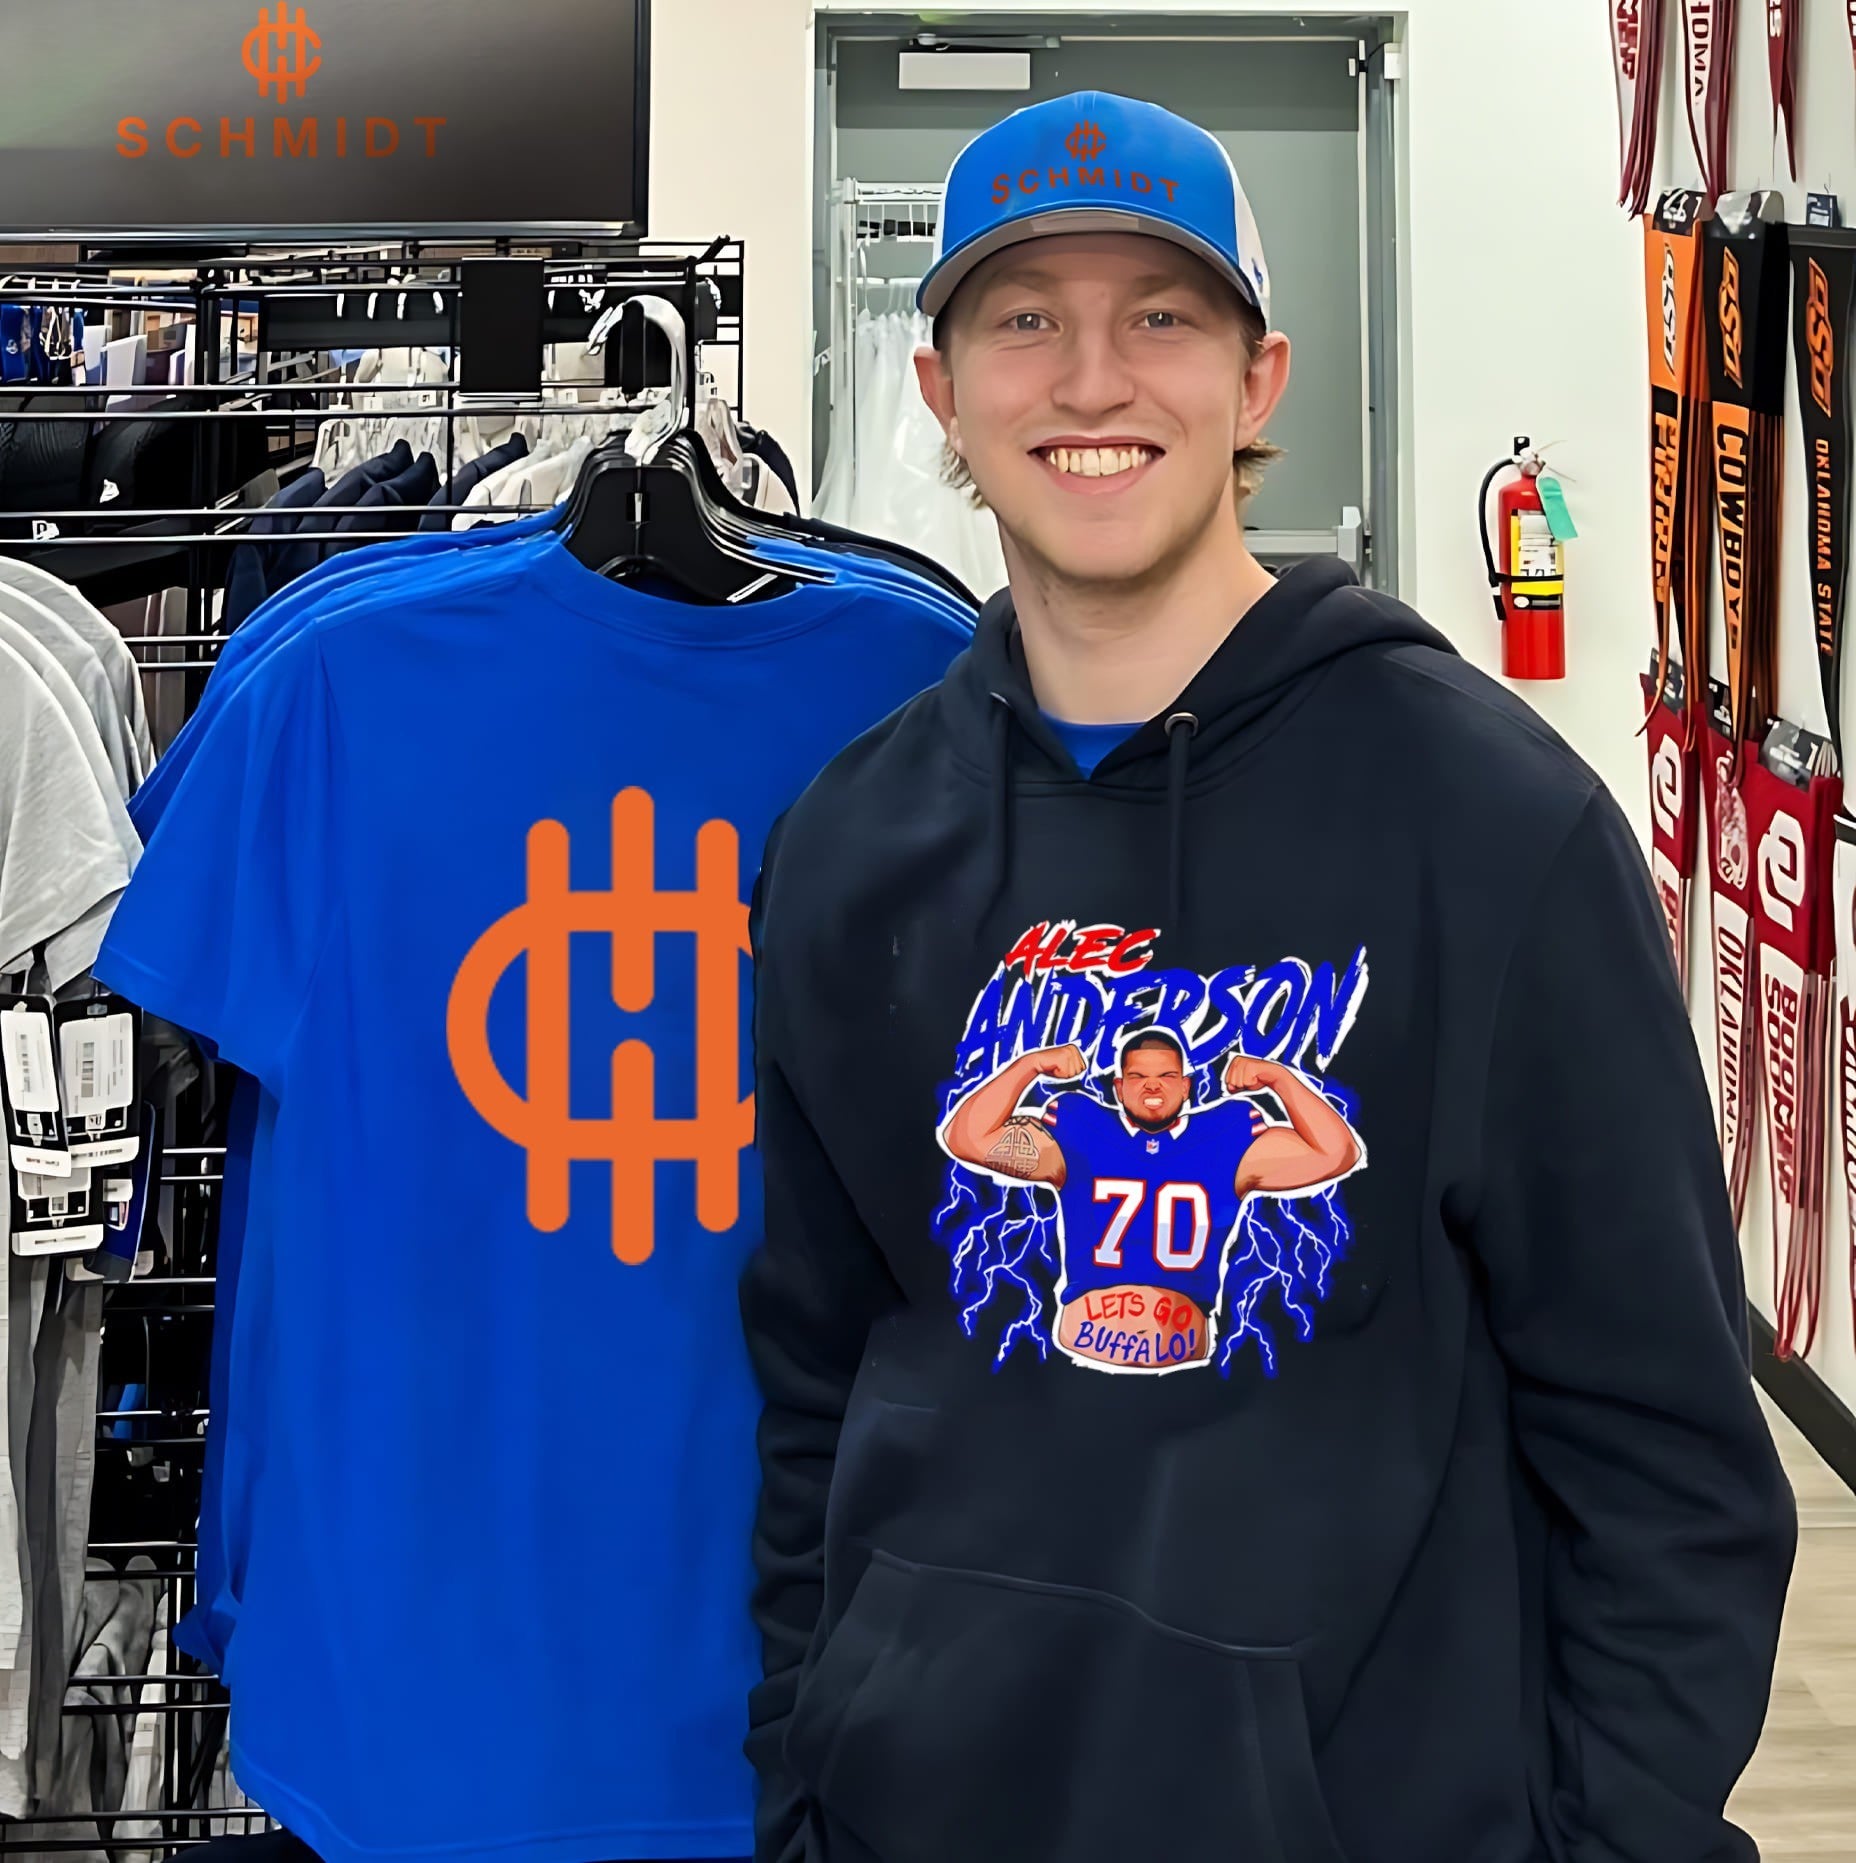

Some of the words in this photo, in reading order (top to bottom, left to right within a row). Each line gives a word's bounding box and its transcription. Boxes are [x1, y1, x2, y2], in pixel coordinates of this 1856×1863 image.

[115, 116, 448, 159] SCHMIDT
[991, 167, 1180, 205] SCHMIDT
[1815, 438, 1832, 571] OKLAHOMA
[1005, 920, 1161, 978] ALEC
[955, 943, 1368, 1078] ANDERSON
[1093, 1177, 1211, 1272] 70
[1083, 1291, 1145, 1321] LETS
[1153, 1301, 1193, 1332] GO
